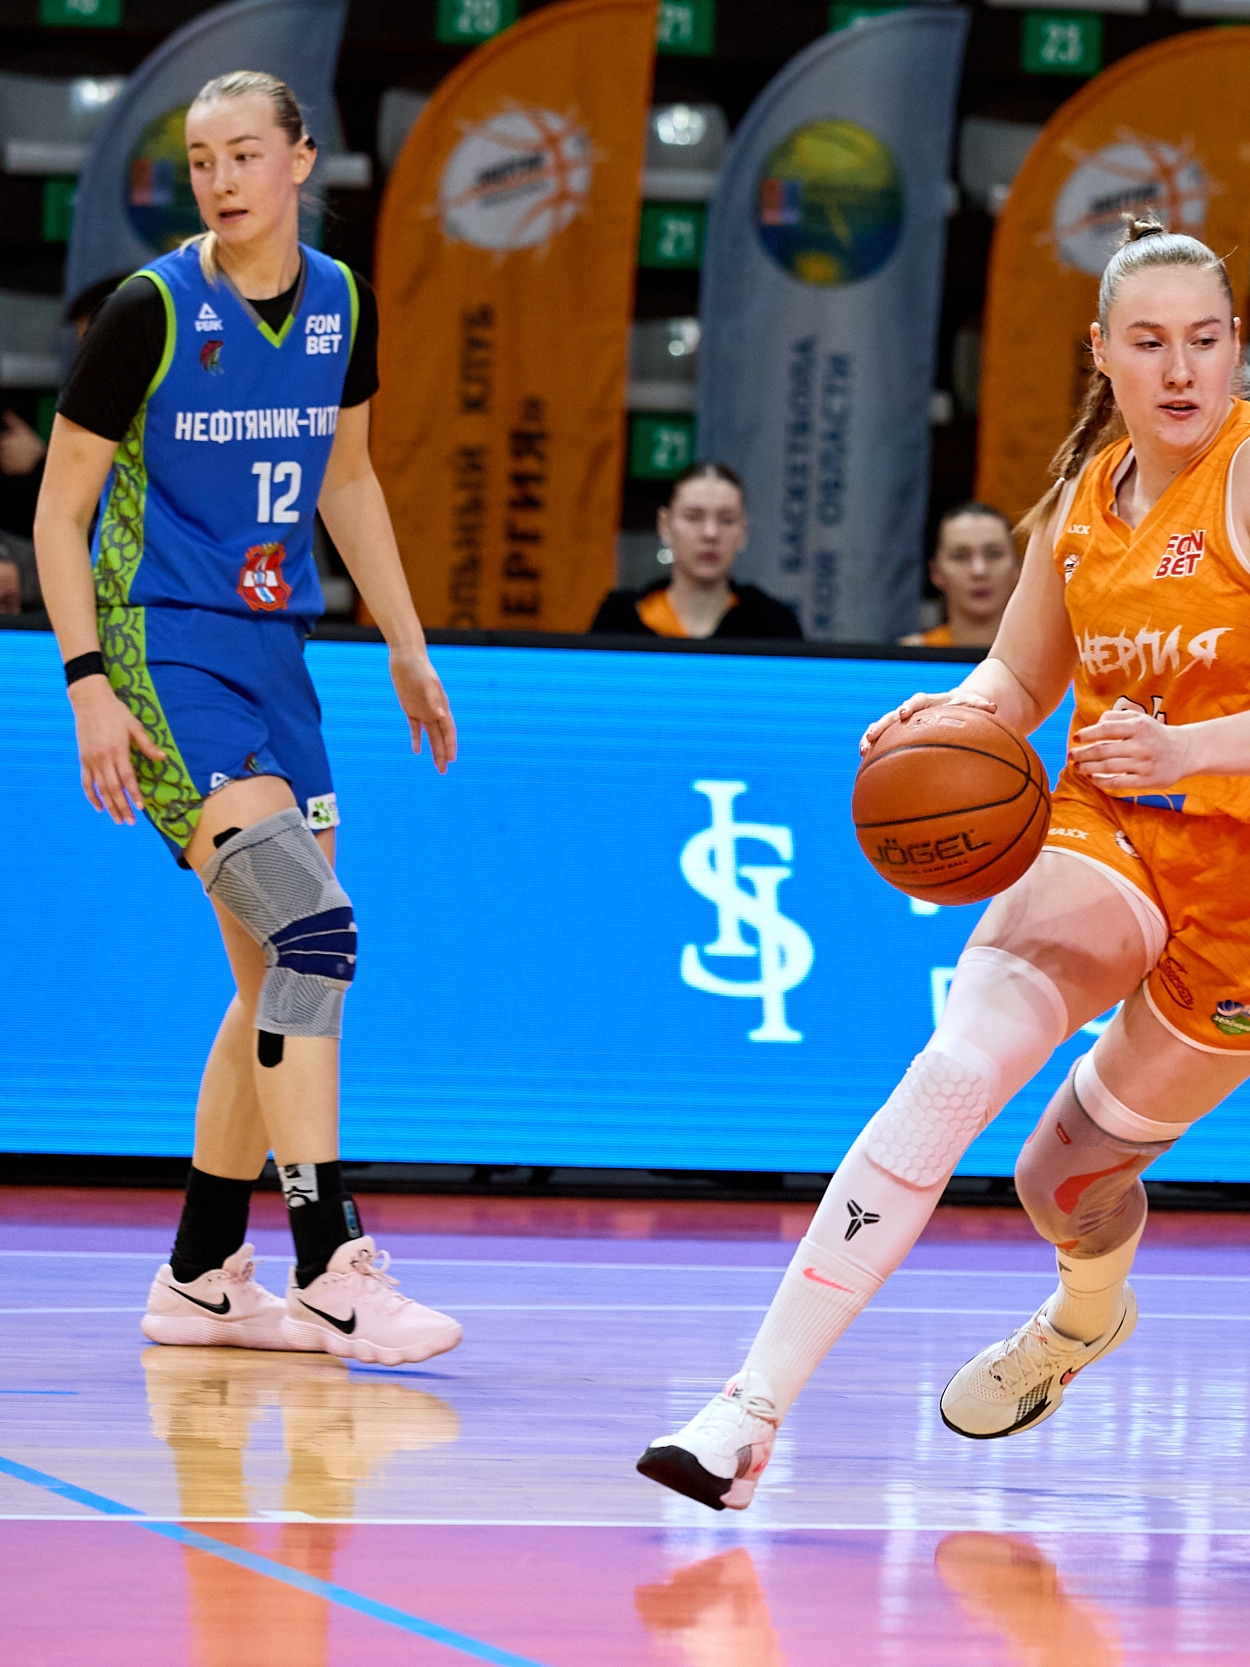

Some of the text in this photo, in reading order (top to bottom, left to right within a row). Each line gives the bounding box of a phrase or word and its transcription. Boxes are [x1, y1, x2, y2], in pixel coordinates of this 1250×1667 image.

[194, 320, 223, 332] PEAK
[305, 314, 341, 335] FON
[306, 334, 343, 355] BET
[251, 461, 302, 523] 12
[1163, 530, 1206, 556] FON
[1154, 554, 1202, 579] BET
[872, 831, 992, 866] JÖGEL
